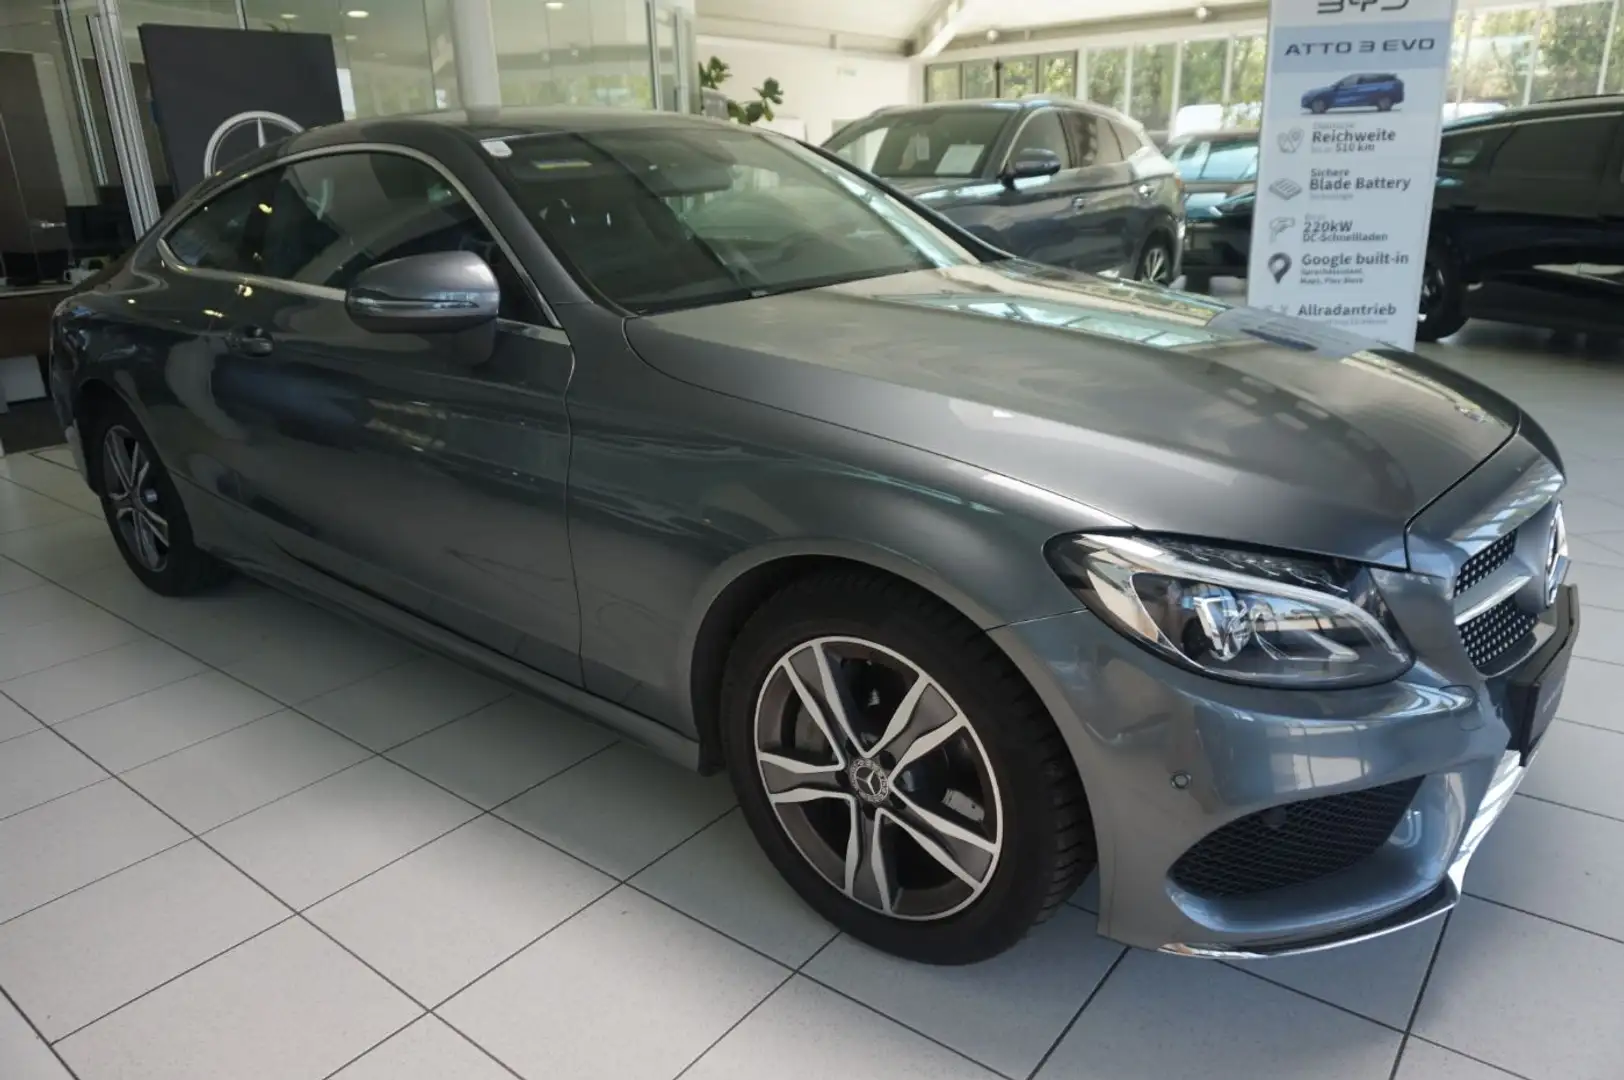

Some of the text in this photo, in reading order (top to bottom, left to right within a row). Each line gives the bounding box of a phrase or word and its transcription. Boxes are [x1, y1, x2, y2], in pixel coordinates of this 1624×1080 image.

[1284, 38, 1435, 56] ATTO 3 EVO
[1312, 128, 1396, 143] Reichweite
[1335, 143, 1355, 153] 510
[1358, 142, 1375, 152] km
[1310, 168, 1350, 177] Sichere
[1309, 176, 1411, 191] Blade Battery
[1304, 219, 1353, 233] 220kW
[1301, 252, 1409, 268] Google built-in
[1297, 303, 1397, 316] Allradantrieb
